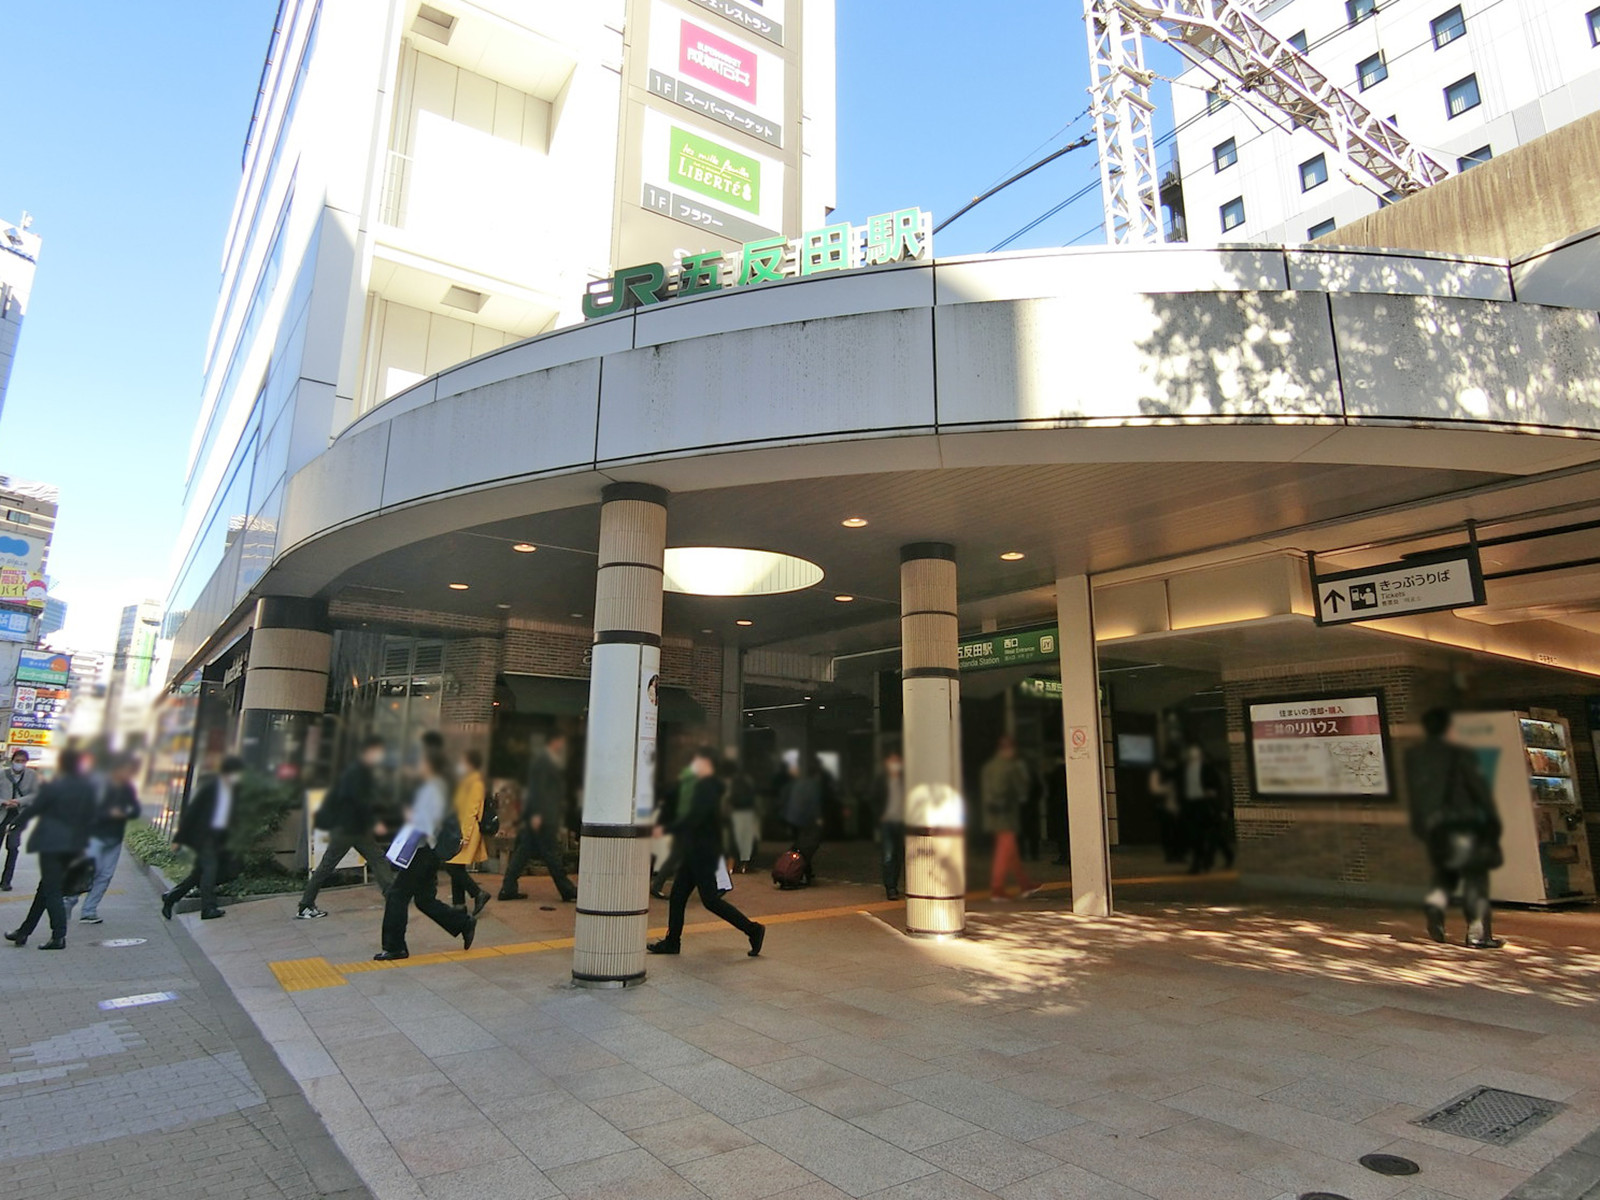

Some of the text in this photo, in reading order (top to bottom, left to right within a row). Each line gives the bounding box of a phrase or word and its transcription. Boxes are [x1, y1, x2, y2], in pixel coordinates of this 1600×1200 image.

[700, 0, 771, 33] ェ・レストラン
[654, 75, 773, 137] 1F スーパーマーケット
[648, 189, 724, 227] 1F フラワー
[1379, 569, 1451, 591] きっぷうりば
[1381, 591, 1406, 599] Tickets
[957, 638, 1018, 658] 五反田駅 西口
[959, 656, 1000, 668] otanda Station
[16, 701, 33, 711] 右側
[1279, 706, 1344, 717] 住まいの売却・購入
